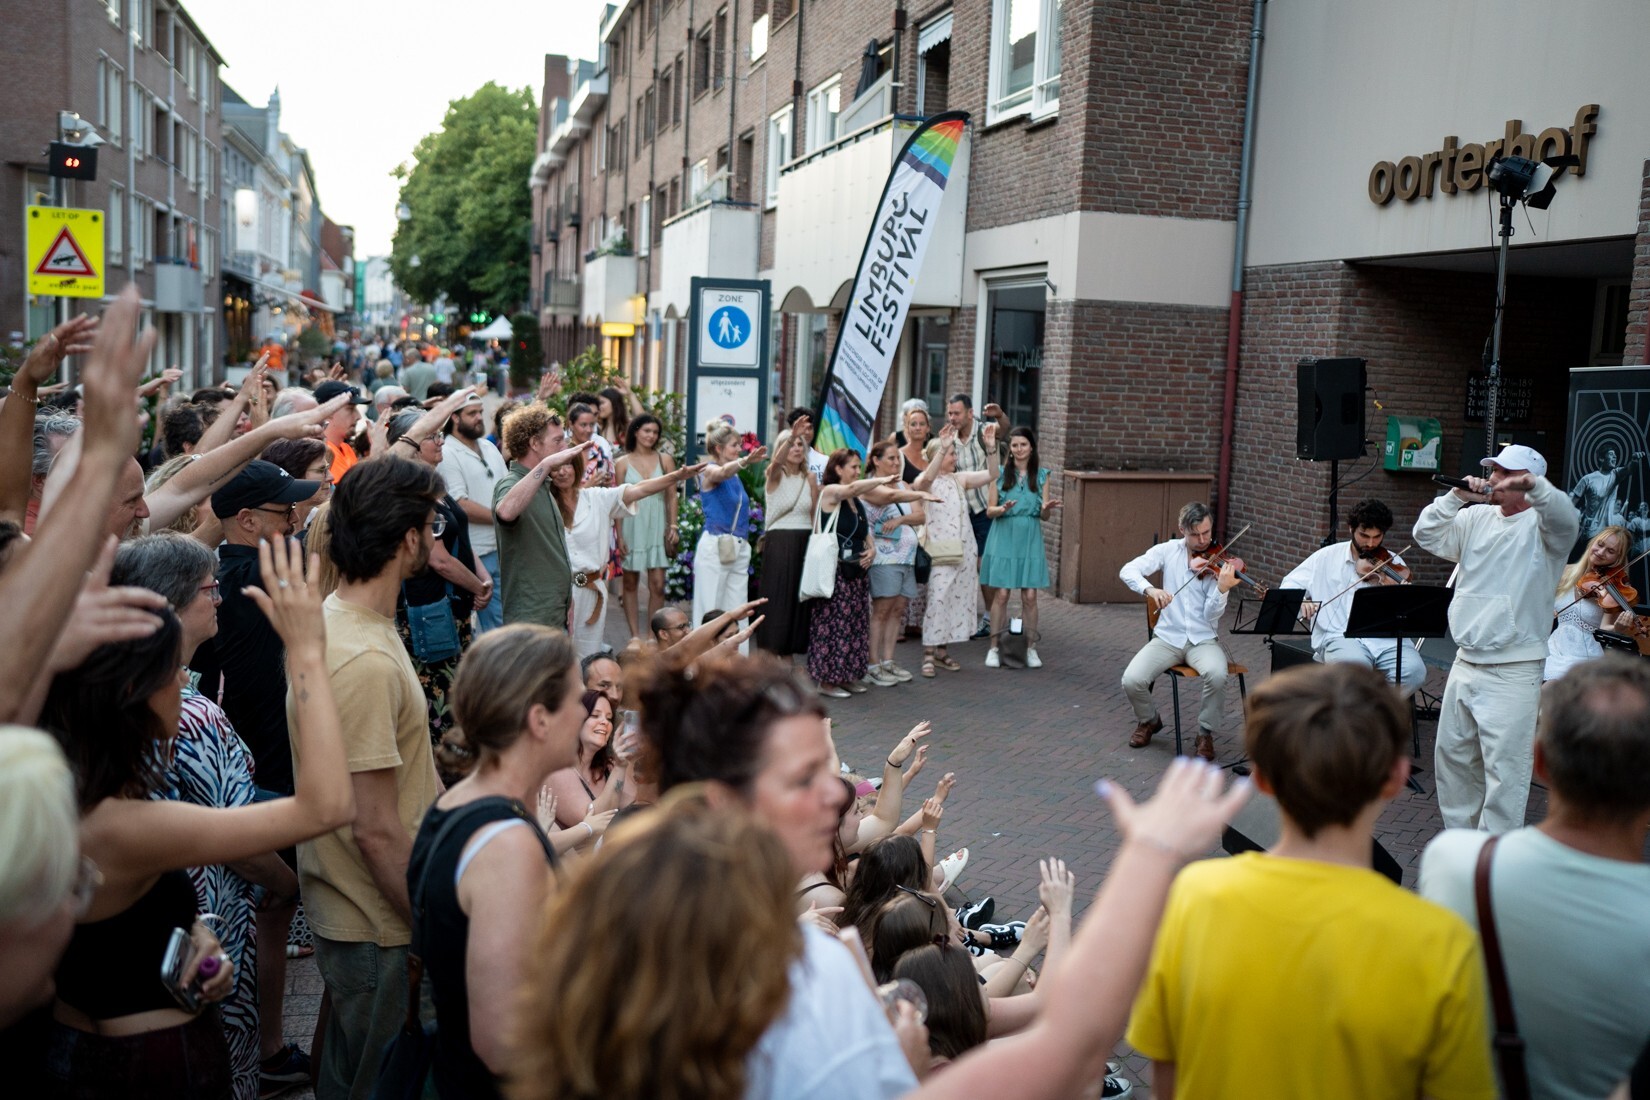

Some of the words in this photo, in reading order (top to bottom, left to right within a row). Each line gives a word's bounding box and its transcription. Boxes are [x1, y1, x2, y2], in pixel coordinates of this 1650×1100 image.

[52, 211, 66, 219] LET
[855, 191, 909, 341] LIMBURG
[870, 207, 929, 358] FESTIVAL
[718, 294, 744, 303] ZONE
[1497, 377, 1508, 387] 67
[1497, 388, 1507, 397] 45
[1496, 398, 1506, 407] 23
[1495, 408, 1504, 417] 01
